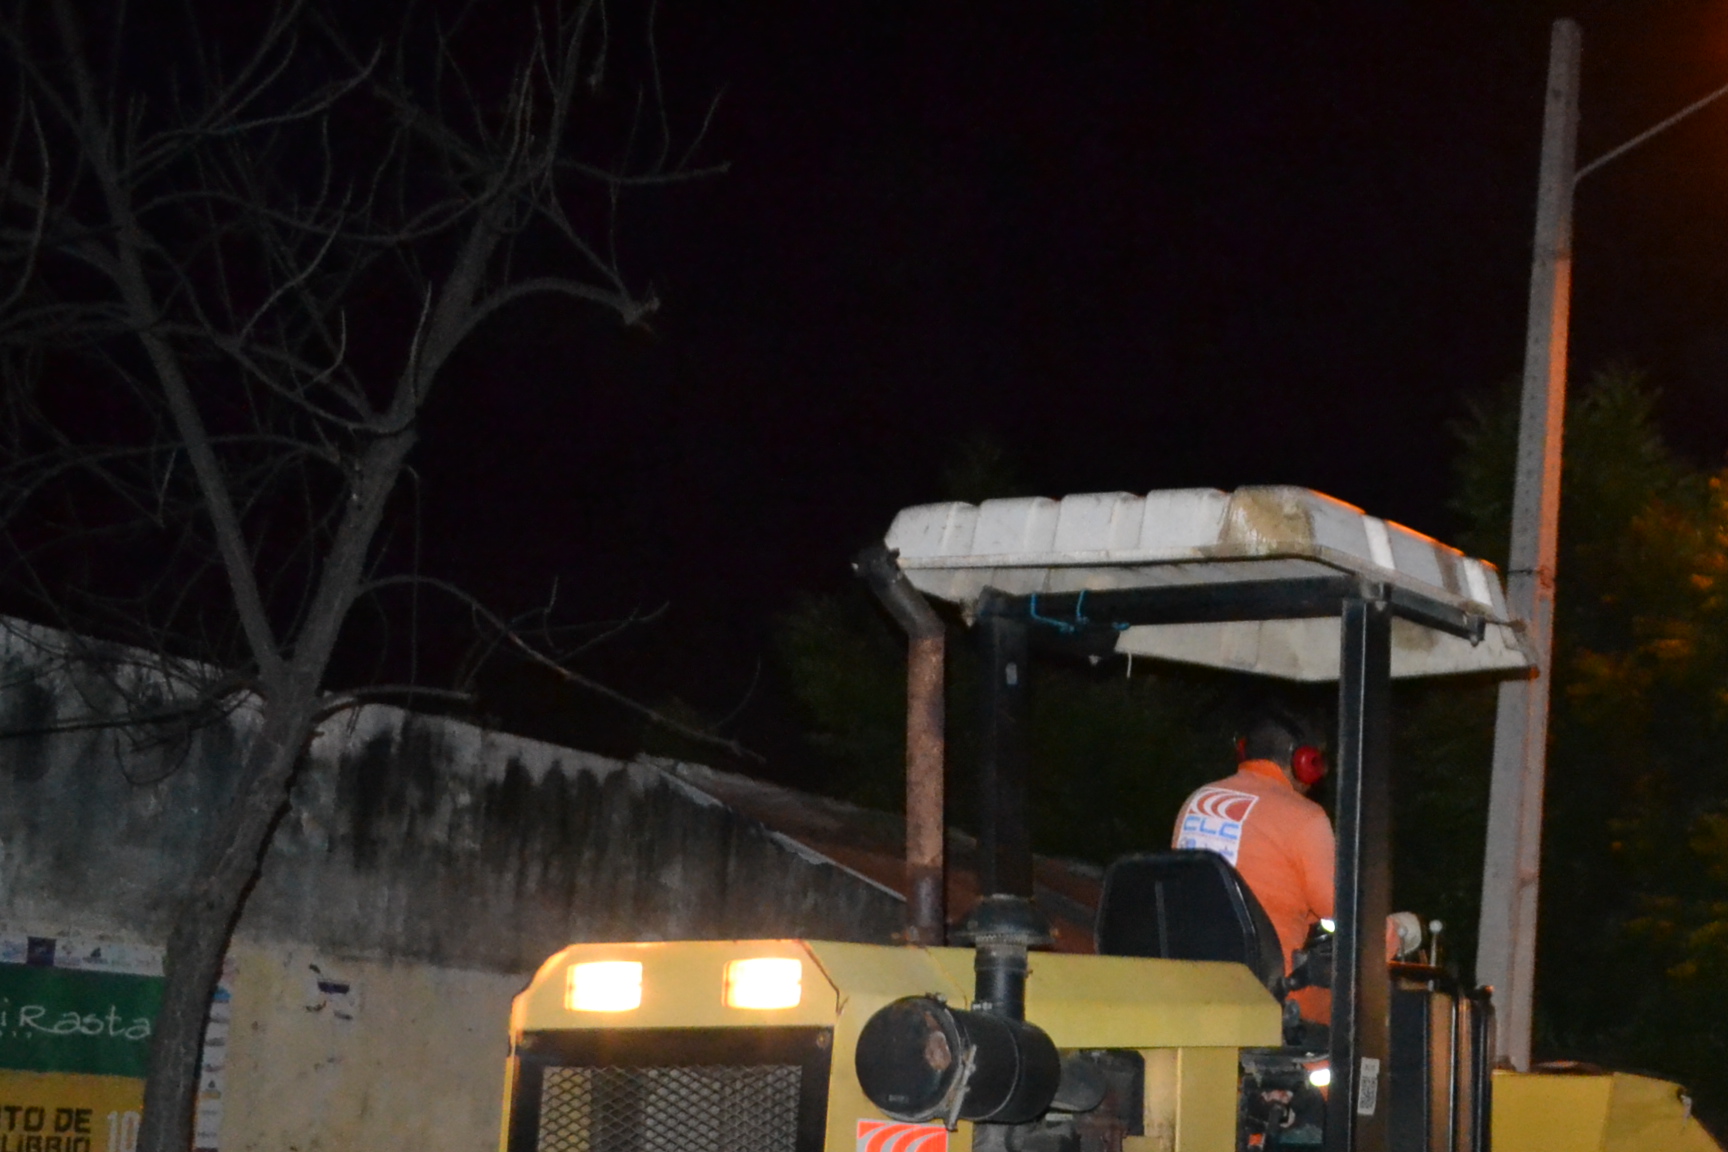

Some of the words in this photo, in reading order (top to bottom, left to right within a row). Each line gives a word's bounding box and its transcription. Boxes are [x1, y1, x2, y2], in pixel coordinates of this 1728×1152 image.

[1183, 815, 1240, 840] CLC
[18, 1004, 152, 1040] Rasta
[54, 1107, 93, 1134] DE
